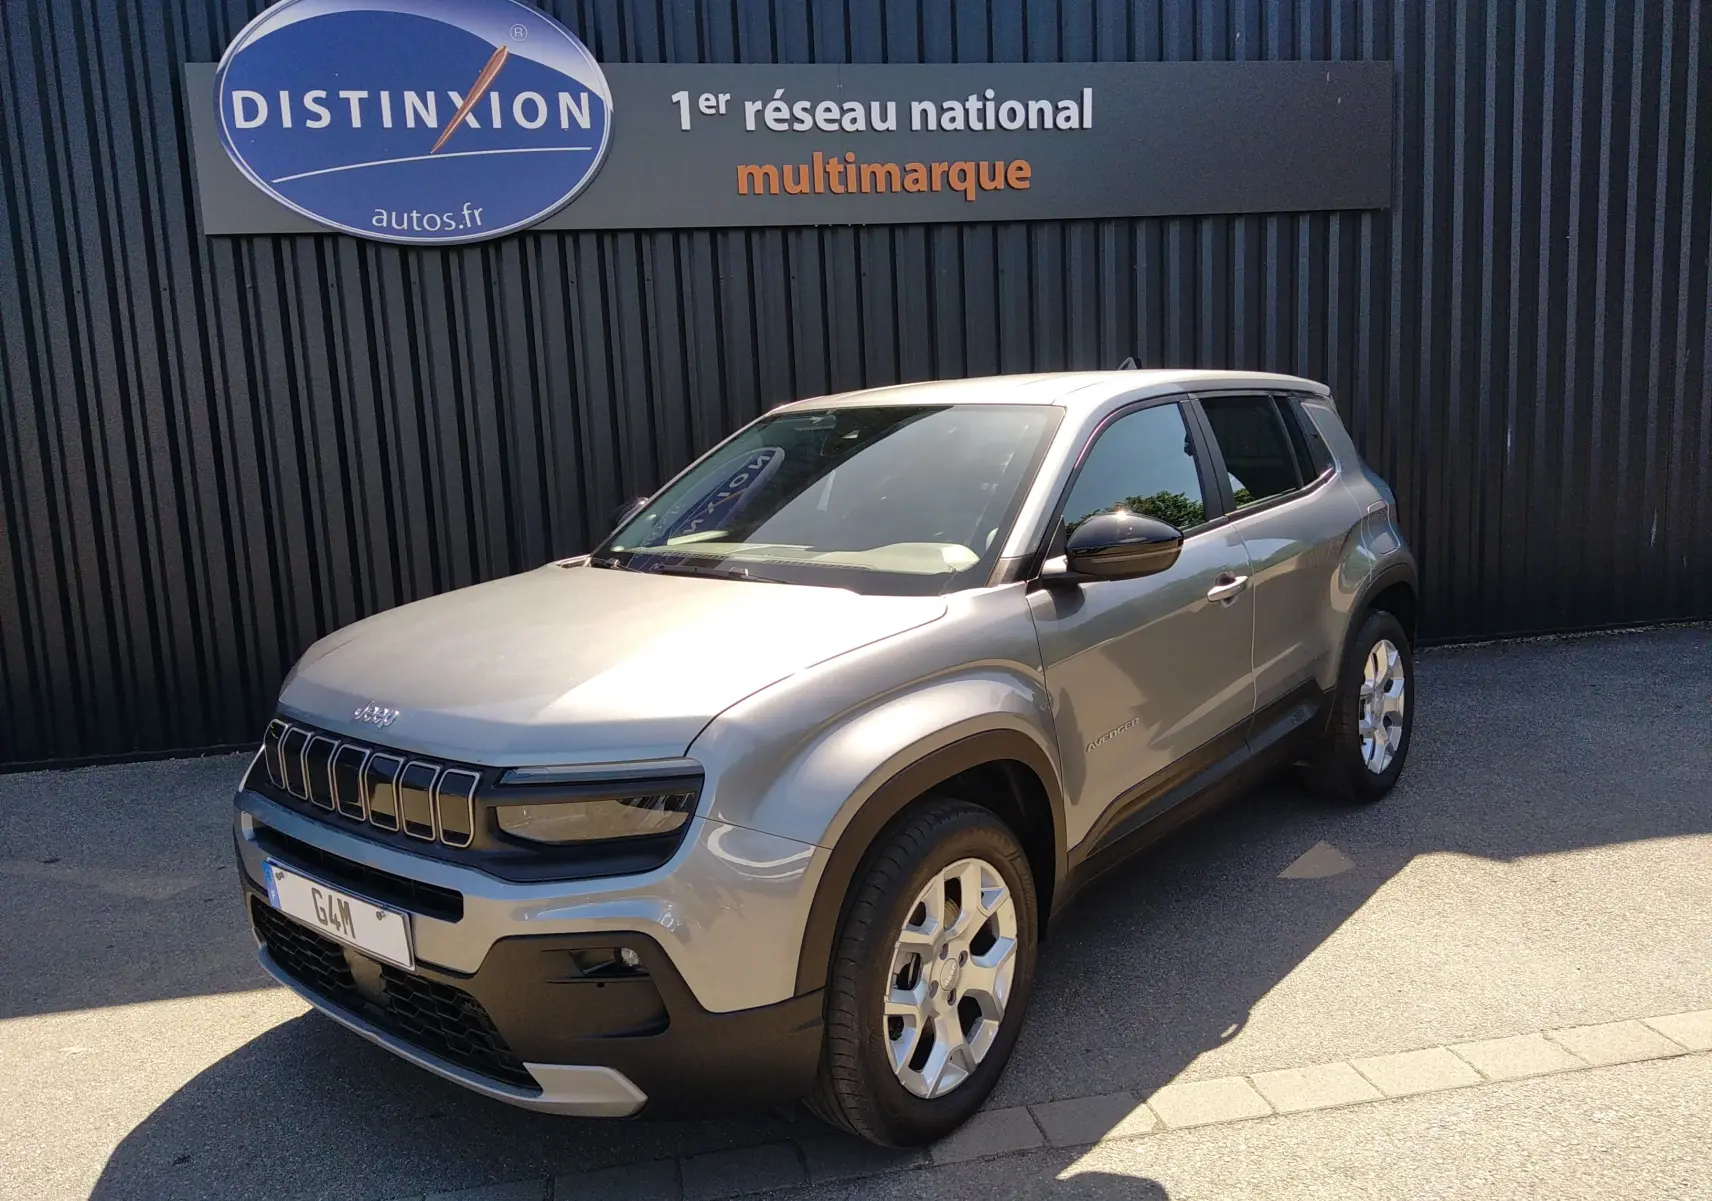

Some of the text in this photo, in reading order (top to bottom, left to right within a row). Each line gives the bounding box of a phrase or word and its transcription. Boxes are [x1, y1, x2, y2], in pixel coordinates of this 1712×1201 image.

[231, 90, 591, 129] DISTINXION
[671, 87, 1093, 132] 1er réseau national
[736, 151, 1032, 202] multimarque
[371, 202, 484, 231] autos.fr
[352, 700, 400, 731] Jeep
[1085, 717, 1139, 752] AVENGER
[311, 887, 356, 940] G4M
